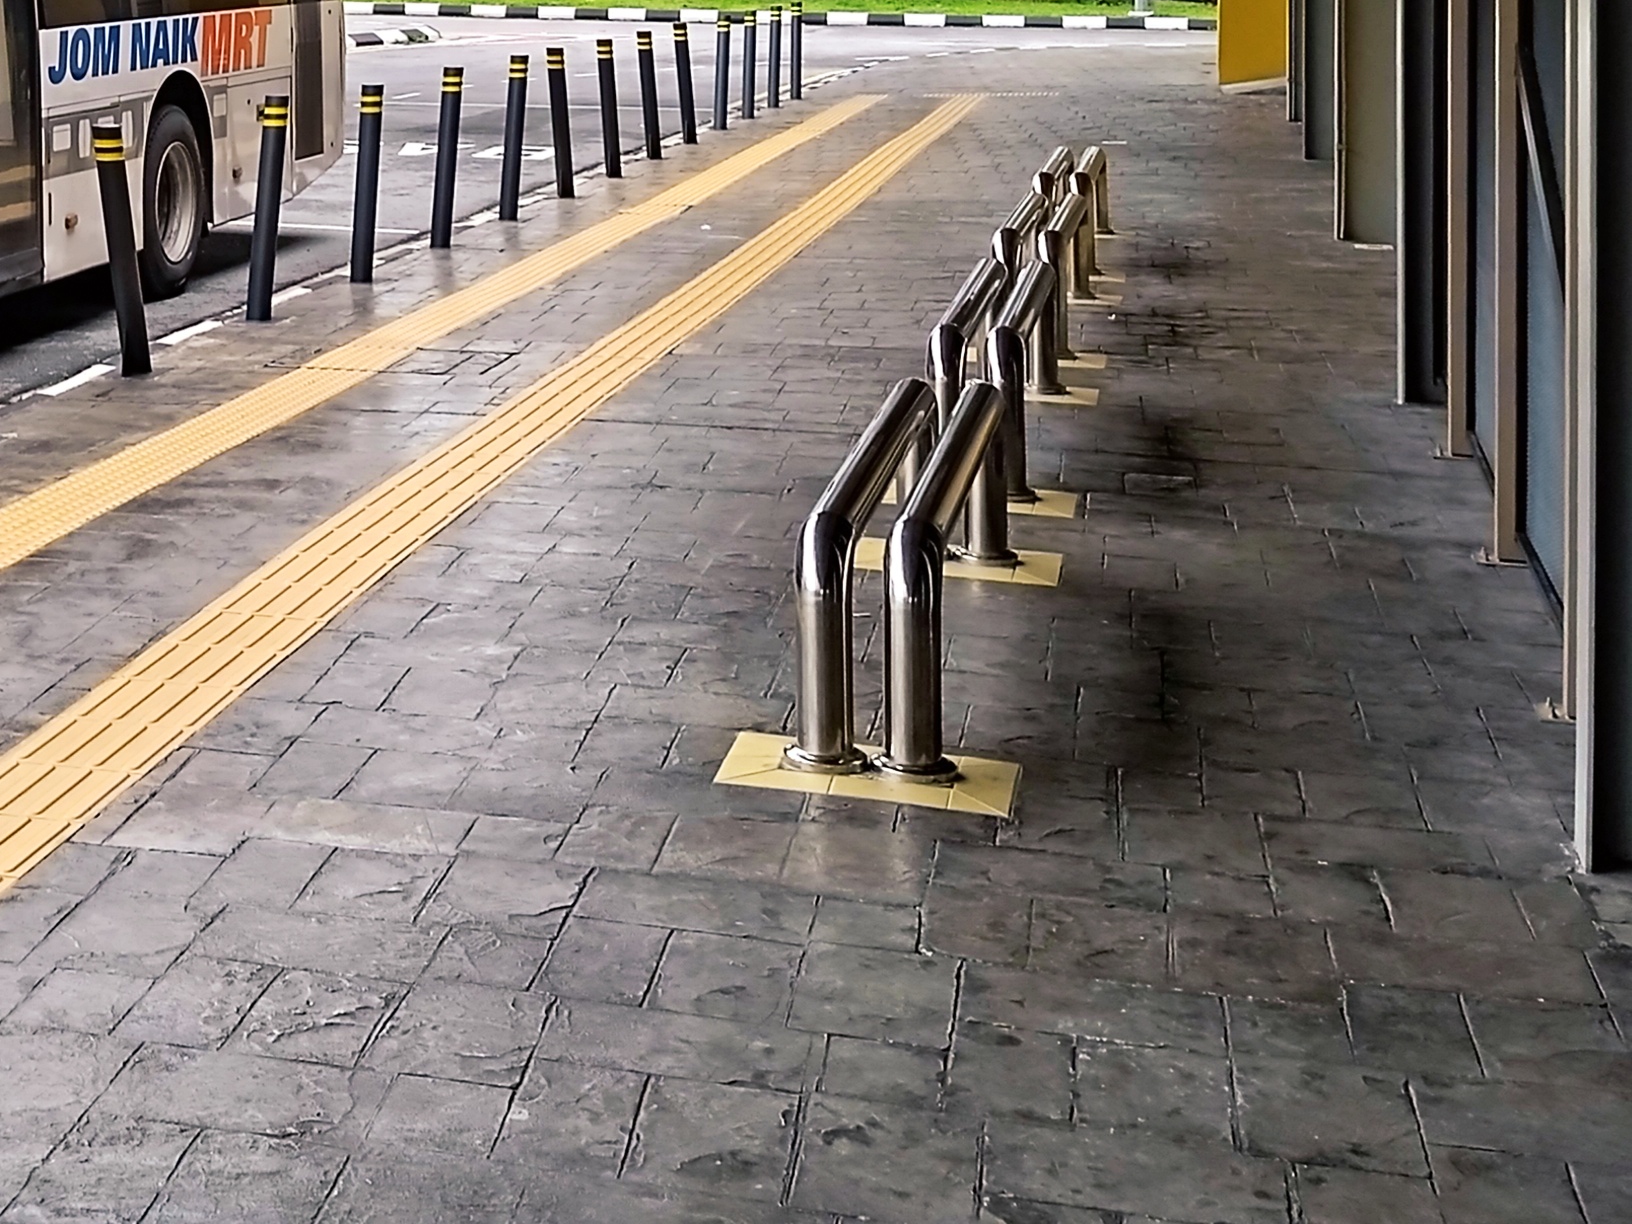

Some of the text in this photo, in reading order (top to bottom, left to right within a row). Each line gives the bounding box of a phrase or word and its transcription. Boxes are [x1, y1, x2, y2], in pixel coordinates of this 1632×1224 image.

[48, 9, 272, 84] JOM NAIK MRT
